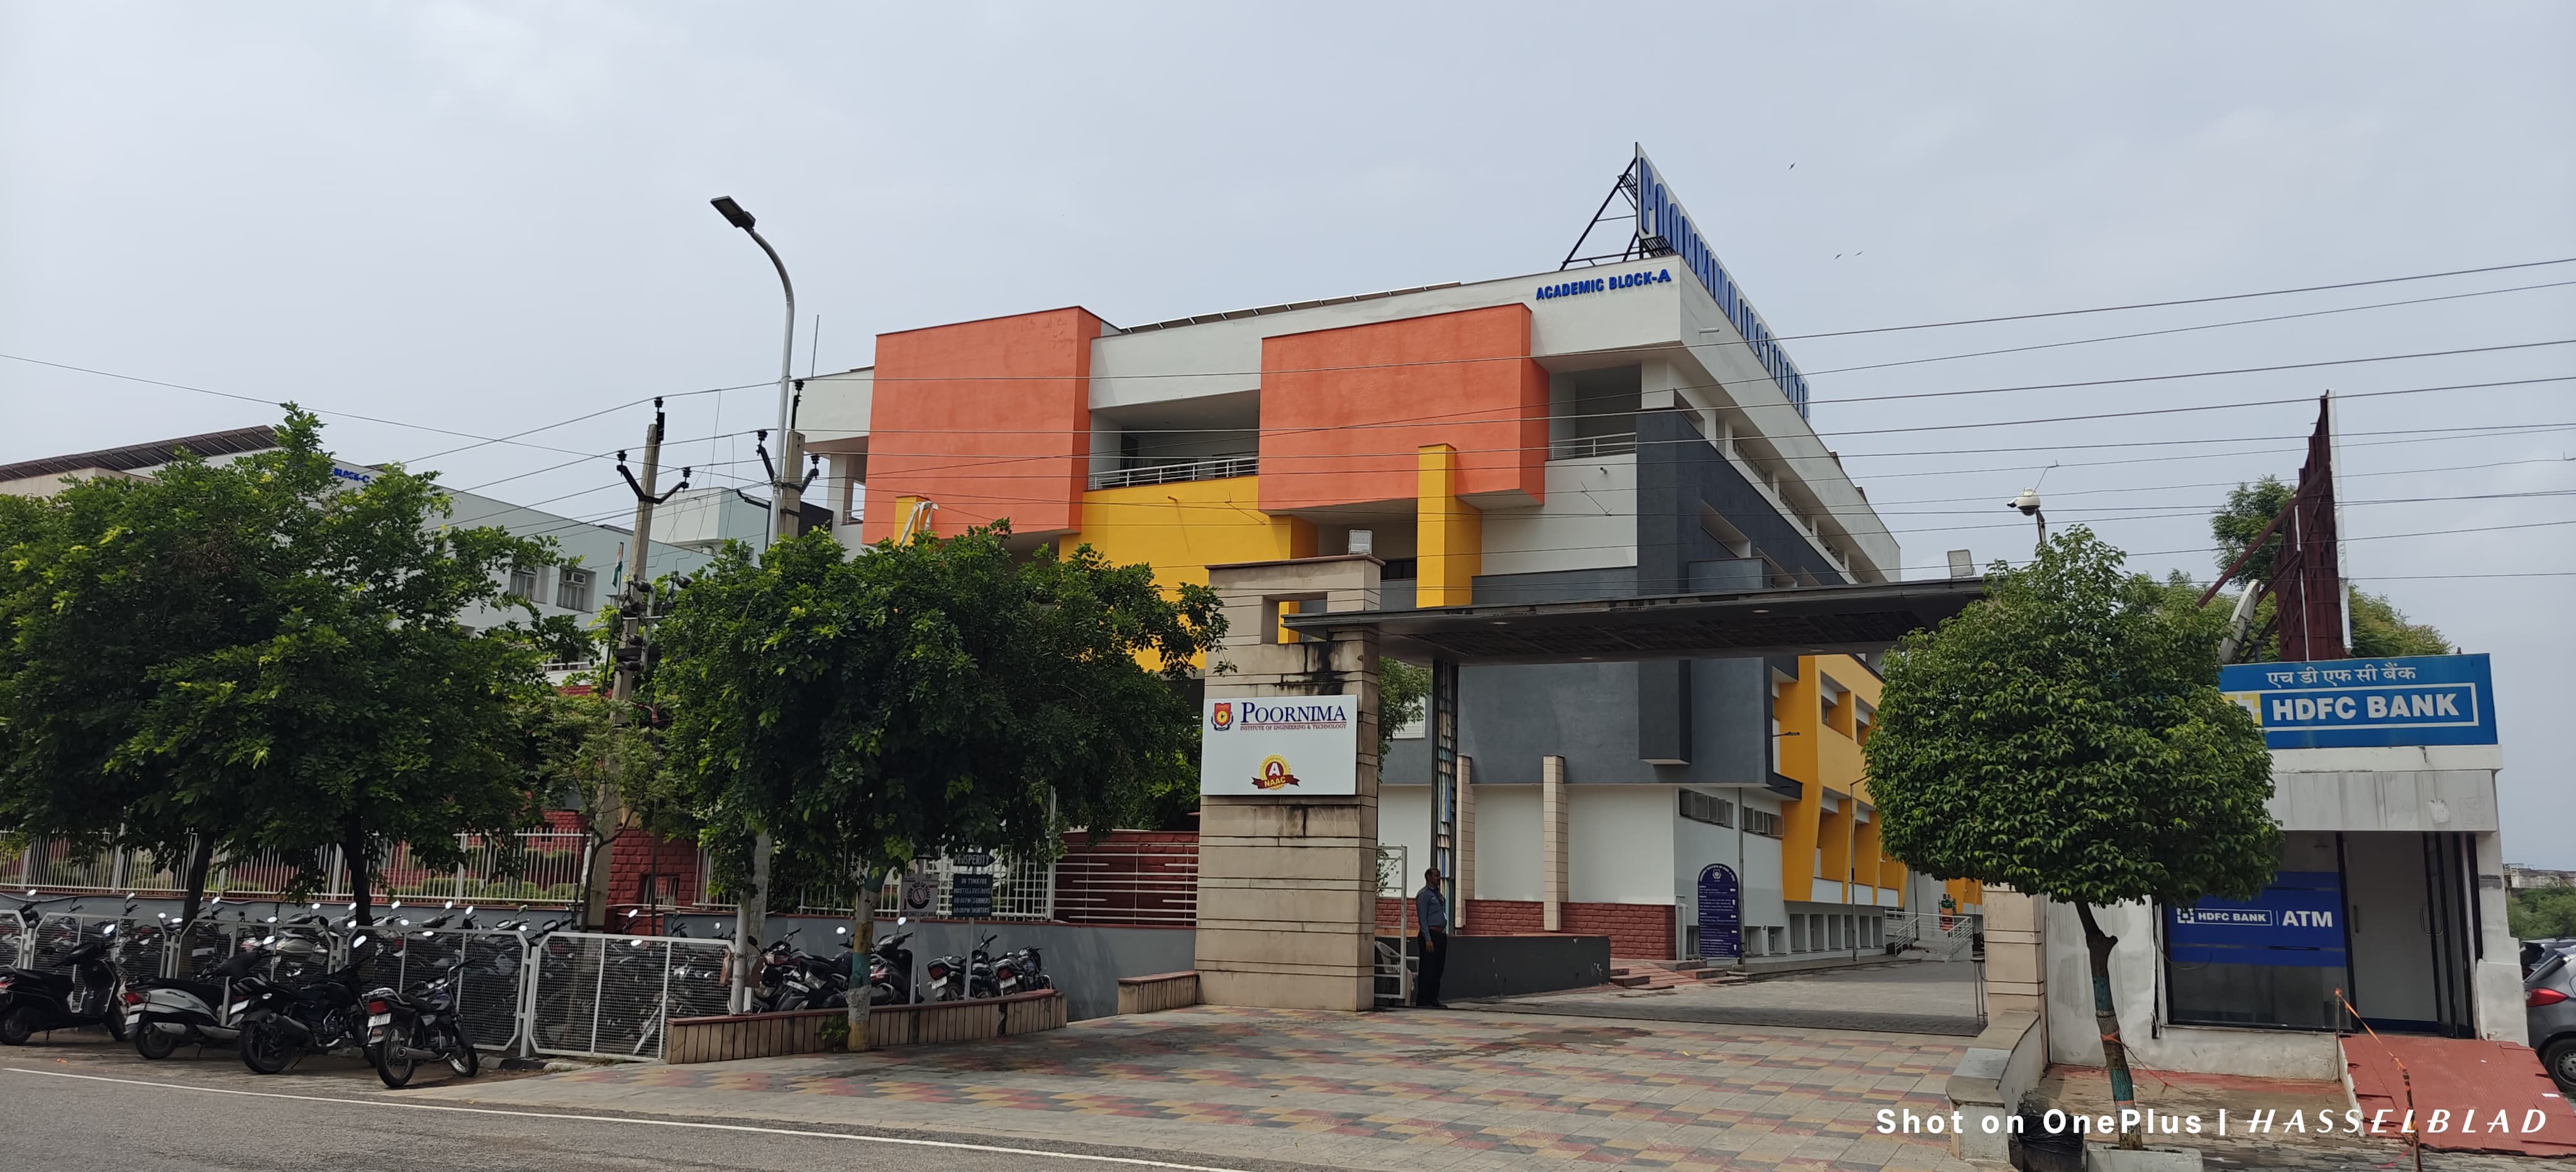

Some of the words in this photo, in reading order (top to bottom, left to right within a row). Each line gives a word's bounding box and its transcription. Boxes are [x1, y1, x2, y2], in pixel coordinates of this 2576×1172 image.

[1536, 278, 1604, 300] ACADEMIC
[1609, 268, 1672, 290] BLOCK-A
[2266, 672, 2294, 688] एच
[2297, 666, 2319, 683] डी
[2321, 670, 2351, 687] एफ
[2354, 663, 2379, 682] सी
[2380, 661, 2416, 681] बैंक
[1240, 702, 1346, 723] POORNIMA
[2272, 696, 2357, 721] HDFC
[2366, 693, 2460, 719] BANK
[1268, 763, 1280, 776] A
[1264, 777, 1286, 787] NAAC
[954, 854, 990, 865] PROSPERITY
[2197, 912, 2229, 921] HDFC
[2233, 913, 2267, 922] BANK
[2282, 910, 2333, 927] ATM
